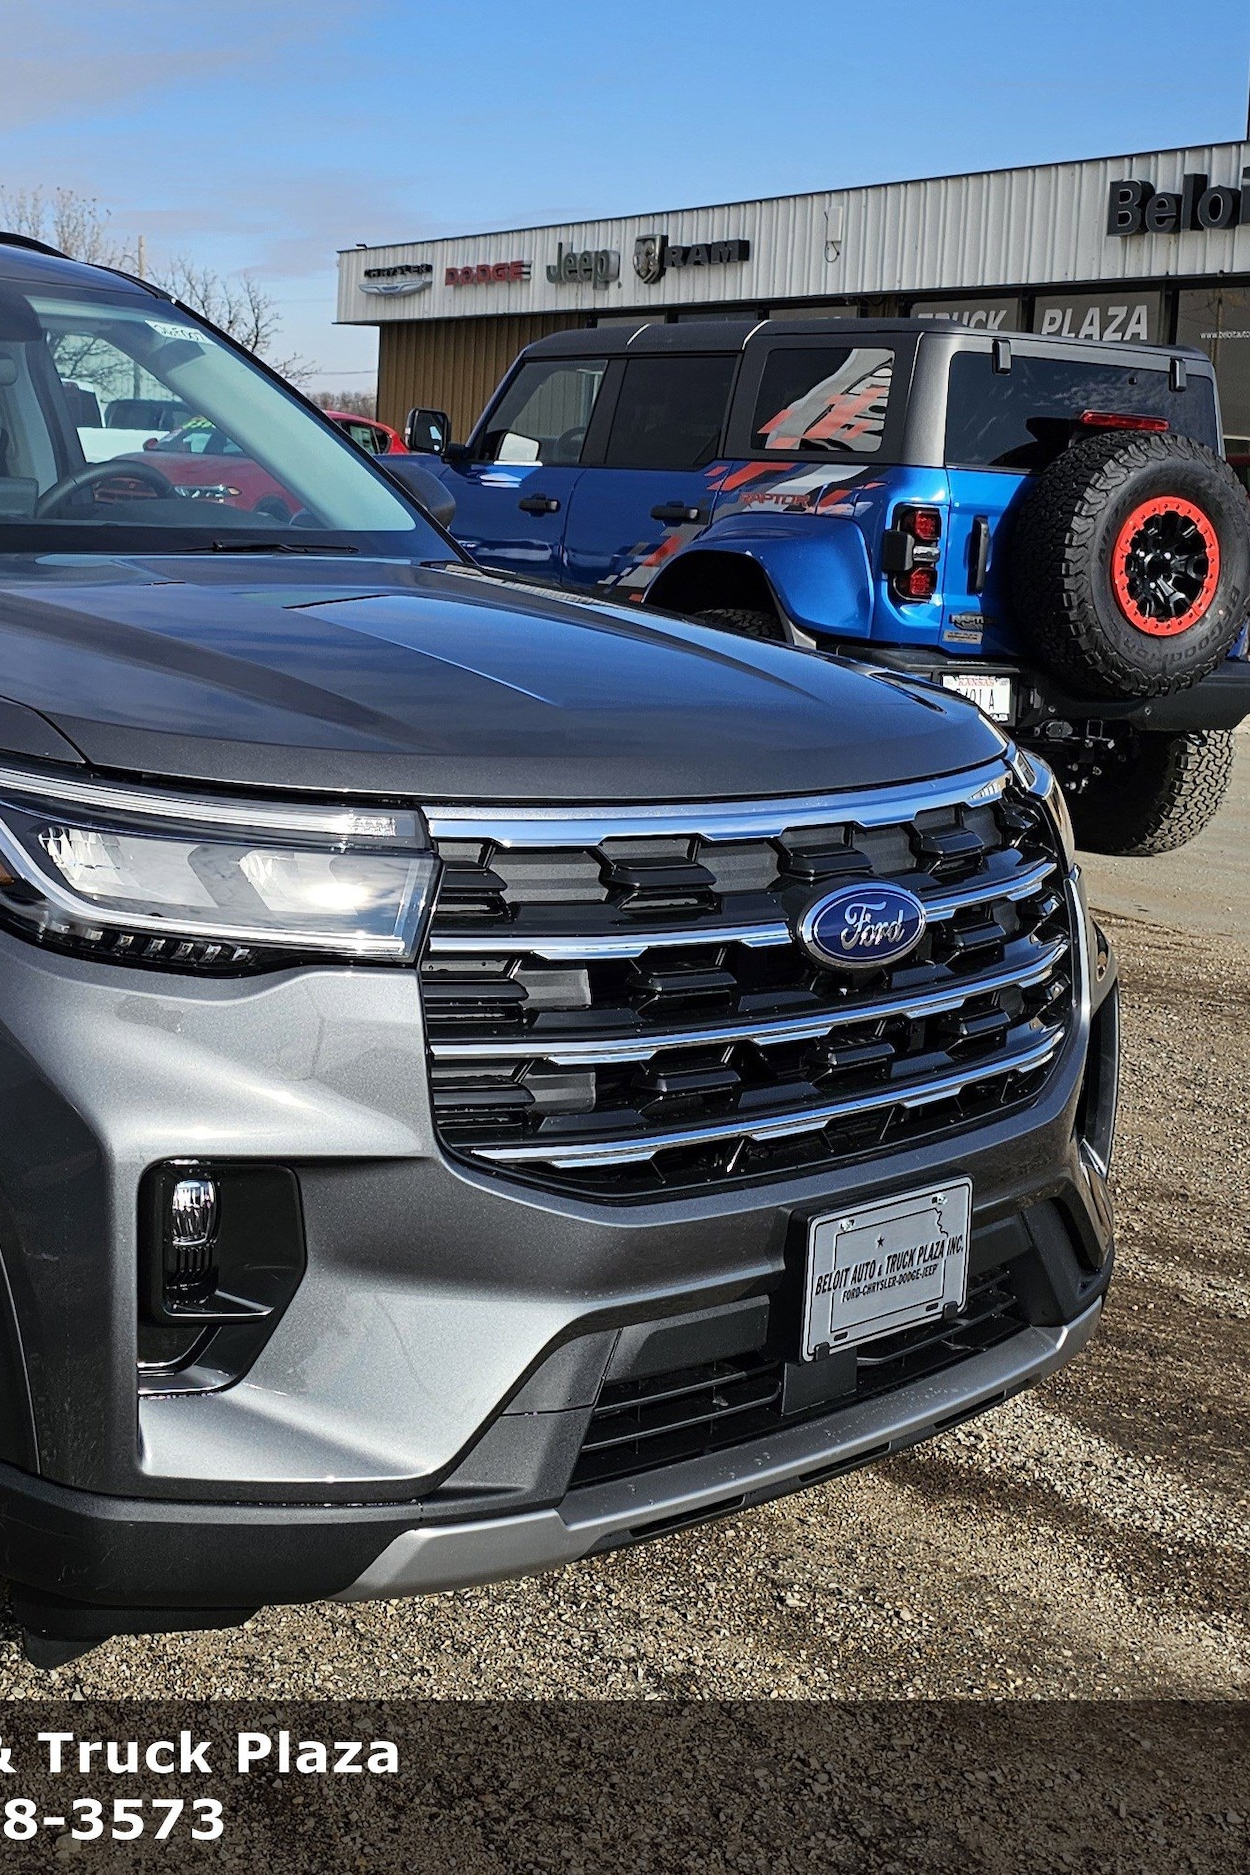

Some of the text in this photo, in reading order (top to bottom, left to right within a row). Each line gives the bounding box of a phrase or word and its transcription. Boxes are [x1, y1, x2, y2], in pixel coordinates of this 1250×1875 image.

[546, 241, 619, 290] Jeep
[664, 239, 747, 268] RAM
[364, 262, 433, 278] CHRYSLER
[445, 260, 529, 286] DODGE
[1042, 304, 1148, 341] PLAZA
[739, 492, 811, 506] RAPTOR
[958, 677, 995, 687] KANSAS
[840, 901, 906, 950] Ford
[814, 1266, 851, 1296] BELOIT
[850, 1259, 877, 1285] AUTO
[885, 1247, 918, 1275] TRUCK
[916, 1239, 946, 1265] PLAZA
[946, 1235, 964, 1257] INC.
